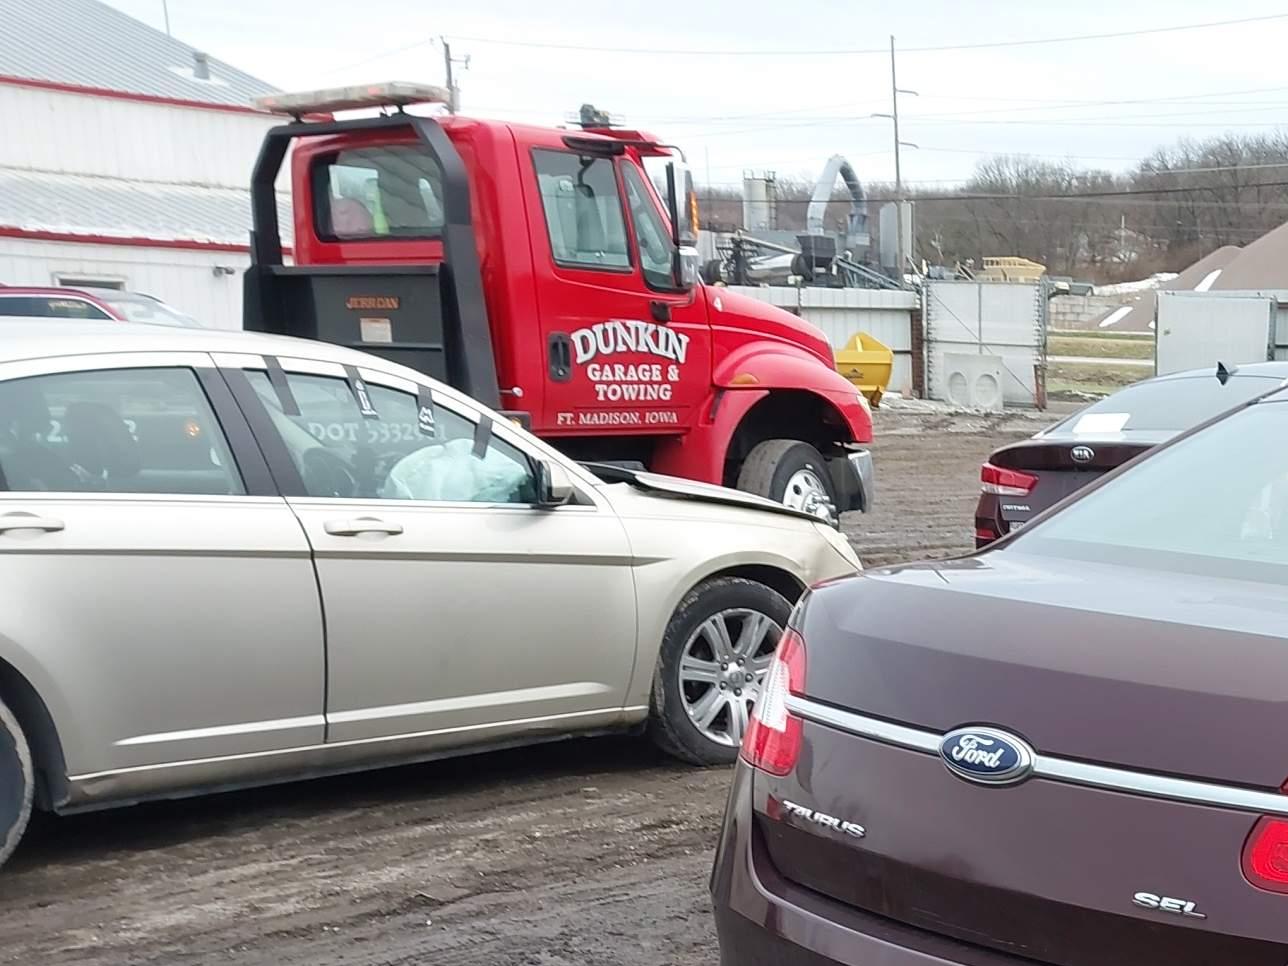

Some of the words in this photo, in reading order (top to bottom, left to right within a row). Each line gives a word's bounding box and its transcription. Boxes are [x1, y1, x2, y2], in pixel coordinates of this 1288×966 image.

[571, 320, 690, 364] DUNKIN
[587, 363, 662, 382] GARAGE
[667, 365, 680, 382] &
[595, 383, 673, 401] TOWING
[557, 412, 575, 425] FT.
[645, 411, 678, 424] IOWA
[308, 422, 359, 441] DOT
[951, 734, 1006, 768] Ford
[783, 800, 865, 838] TAURUS
[1132, 892, 1206, 918] SEL
